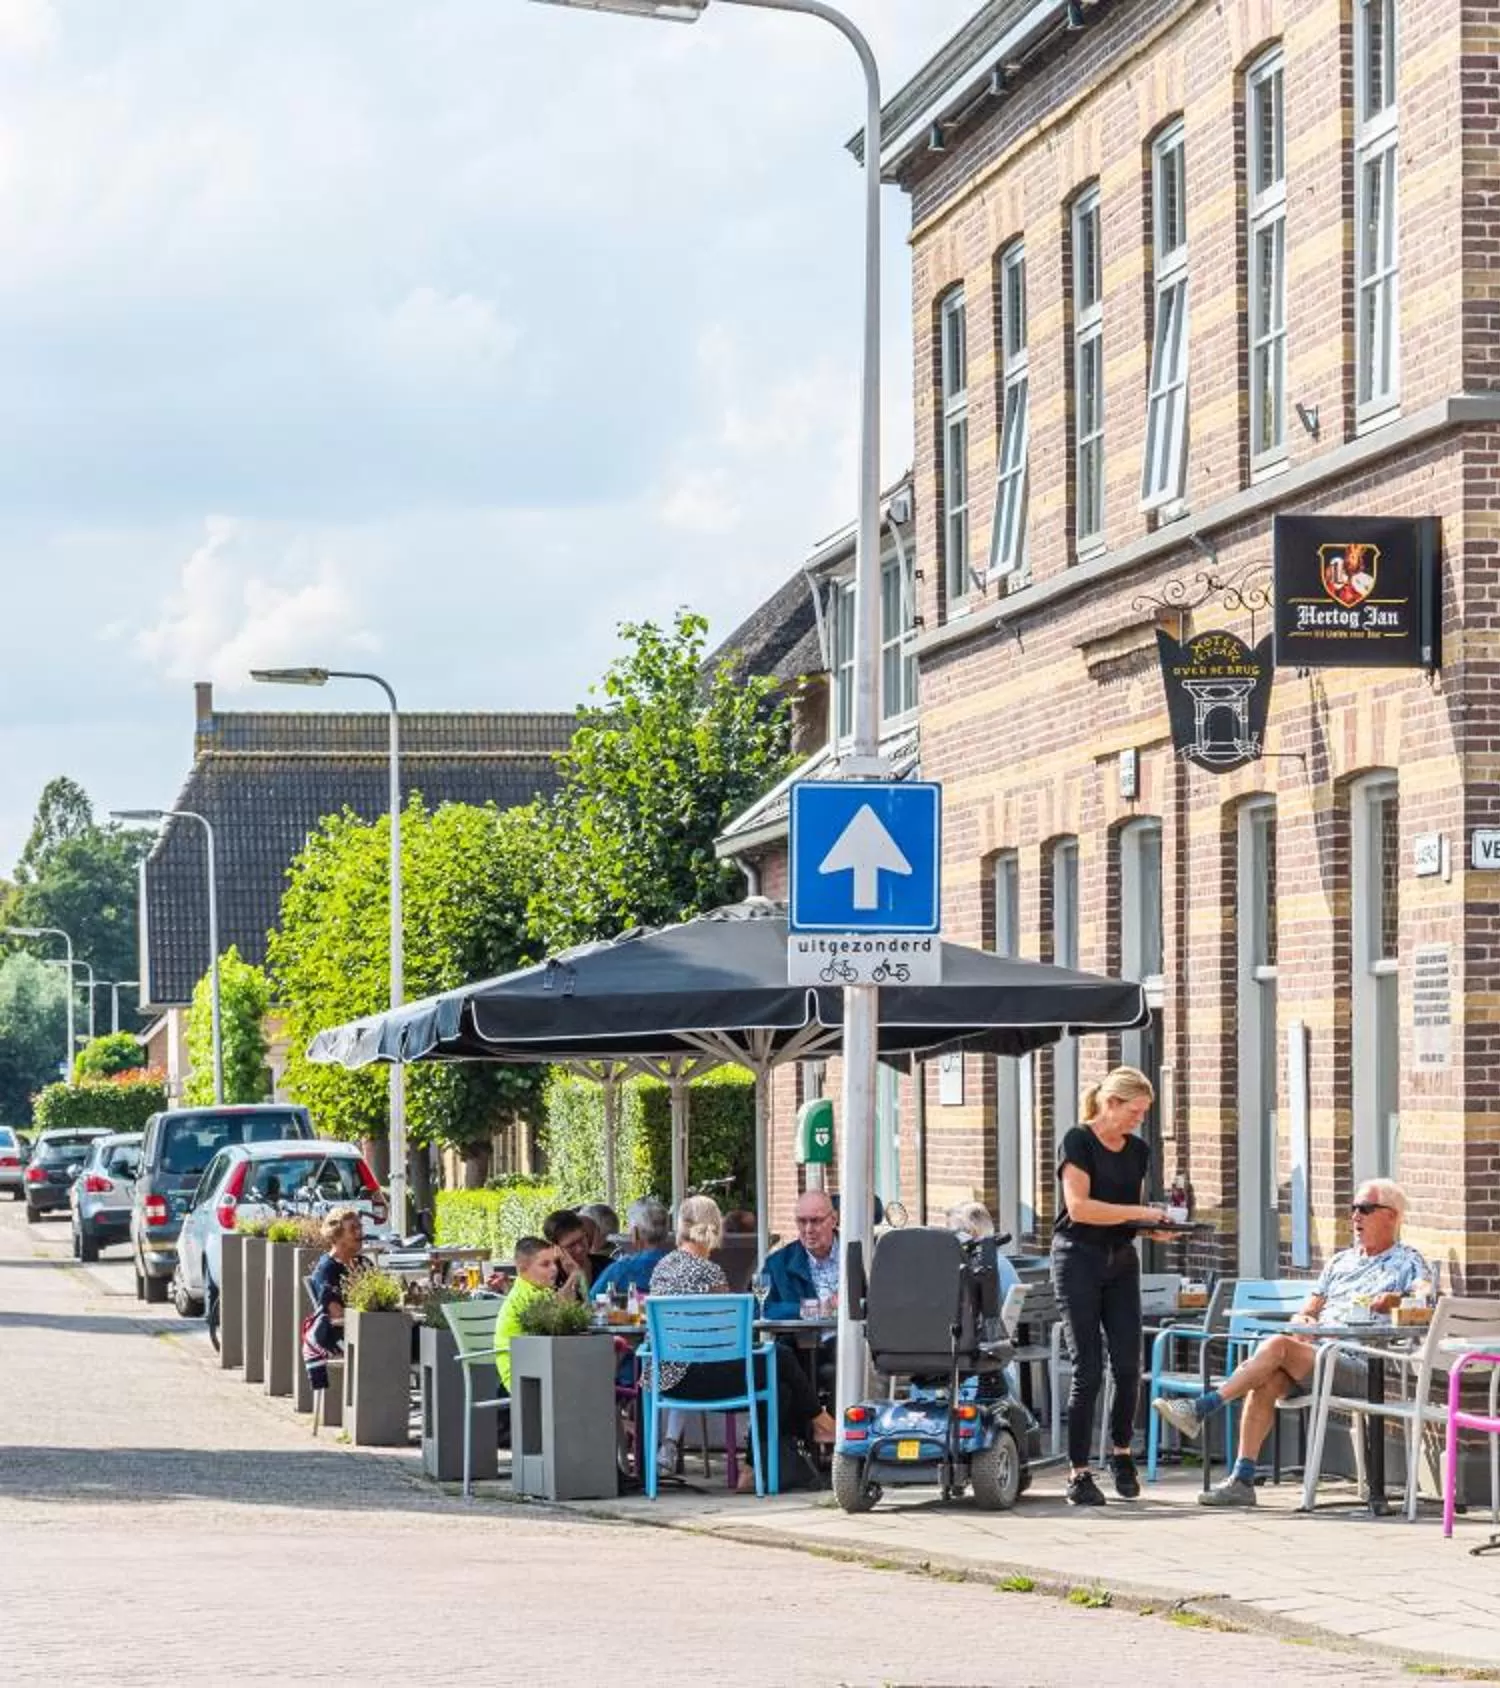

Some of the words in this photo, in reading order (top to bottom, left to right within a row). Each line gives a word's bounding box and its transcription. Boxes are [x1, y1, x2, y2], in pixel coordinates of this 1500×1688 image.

[1297, 605, 1360, 630] Hertog
[1363, 605, 1399, 631] Jan
[1173, 665, 1207, 675] OVER
[1227, 664, 1261, 675] BRUG
[799, 938, 931, 956] uitgezonderd
